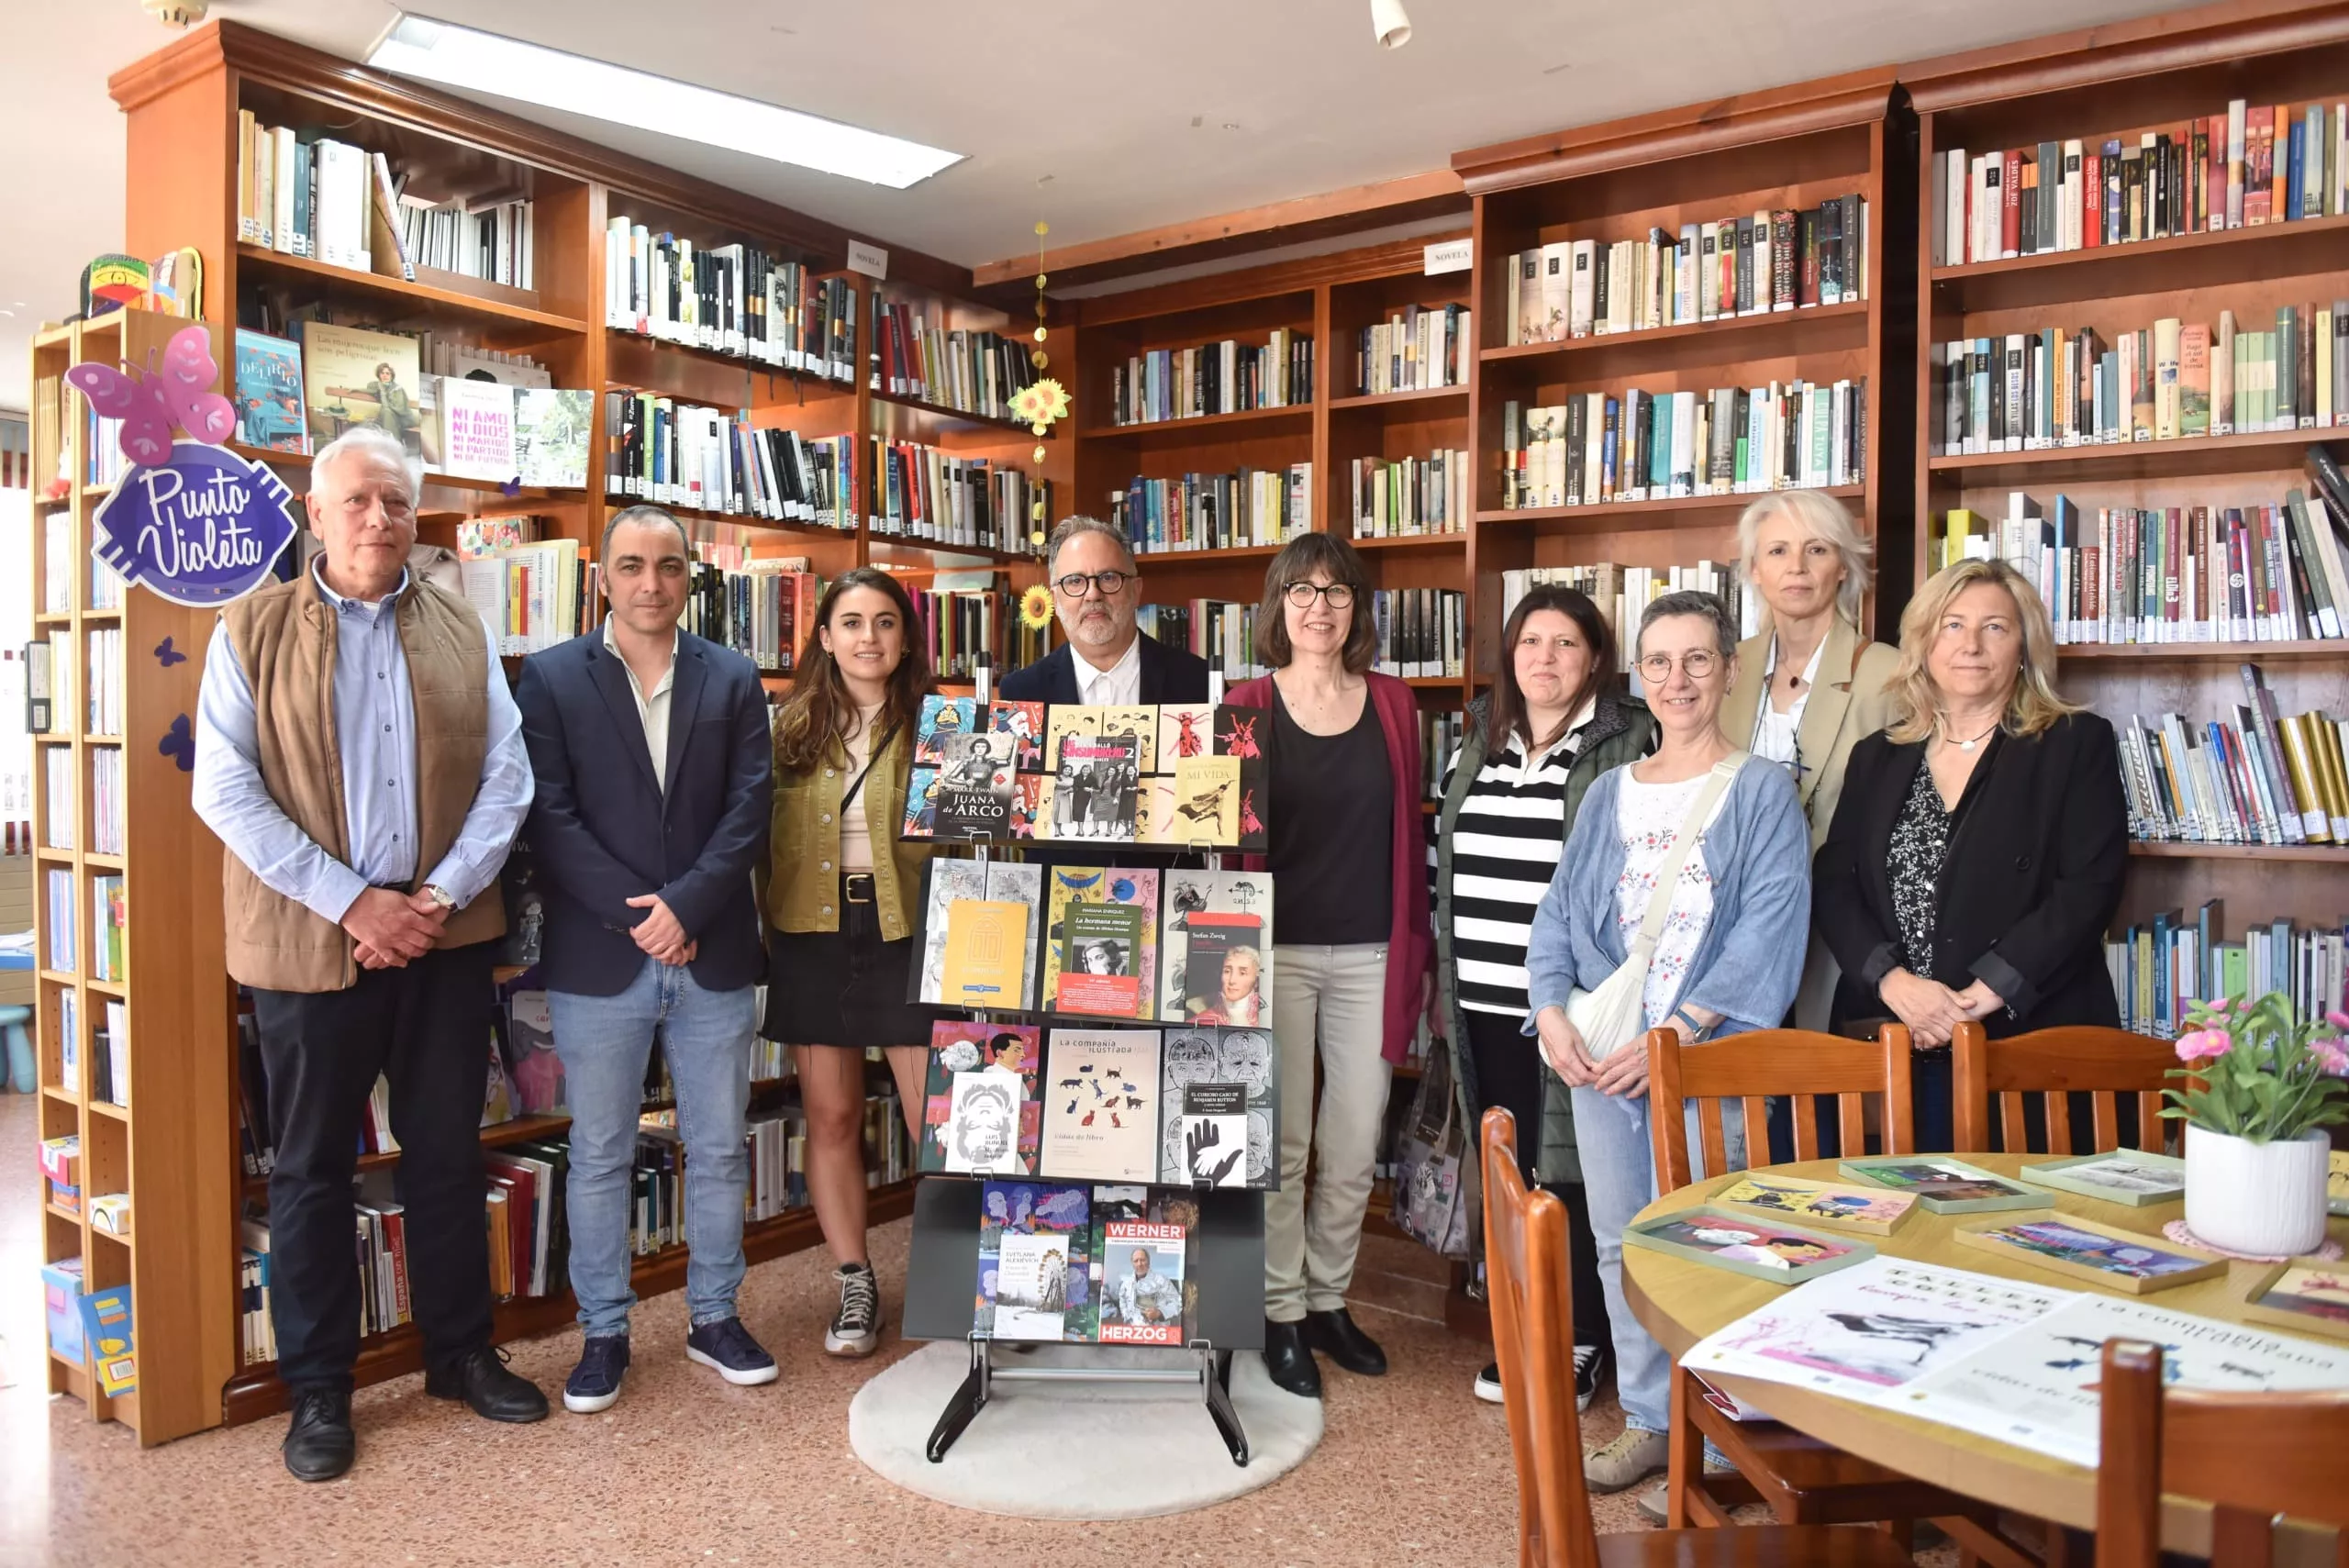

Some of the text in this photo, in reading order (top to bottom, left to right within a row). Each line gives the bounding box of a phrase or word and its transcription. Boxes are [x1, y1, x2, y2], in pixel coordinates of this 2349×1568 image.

[2010, 160, 2019, 189] VALDÉS
[856, 252, 880, 266] NOVELA
[1435, 251, 1468, 261] NOVELA
[317, 335, 330, 345] Las
[241, 361, 296, 386] DELIRIO
[452, 407, 508, 425] NI AMO
[452, 423, 508, 439] NI DIOS
[1814, 402, 1830, 468] CULPA TUYA
[468, 438, 508, 448] MARIDO
[467, 446, 509, 457] PARTIDO
[139, 467, 250, 526] Punto
[138, 506, 262, 578] Violeta
[1125, 748, 1134, 759] 2
[1187, 771, 1230, 779] MI VIDA
[953, 795, 995, 806] JUANA
[955, 805, 1003, 817] ARCO
[1110, 1223, 1181, 1238] WERNER
[396, 1276, 406, 1312] España
[1102, 1327, 1167, 1340] HERZOG
